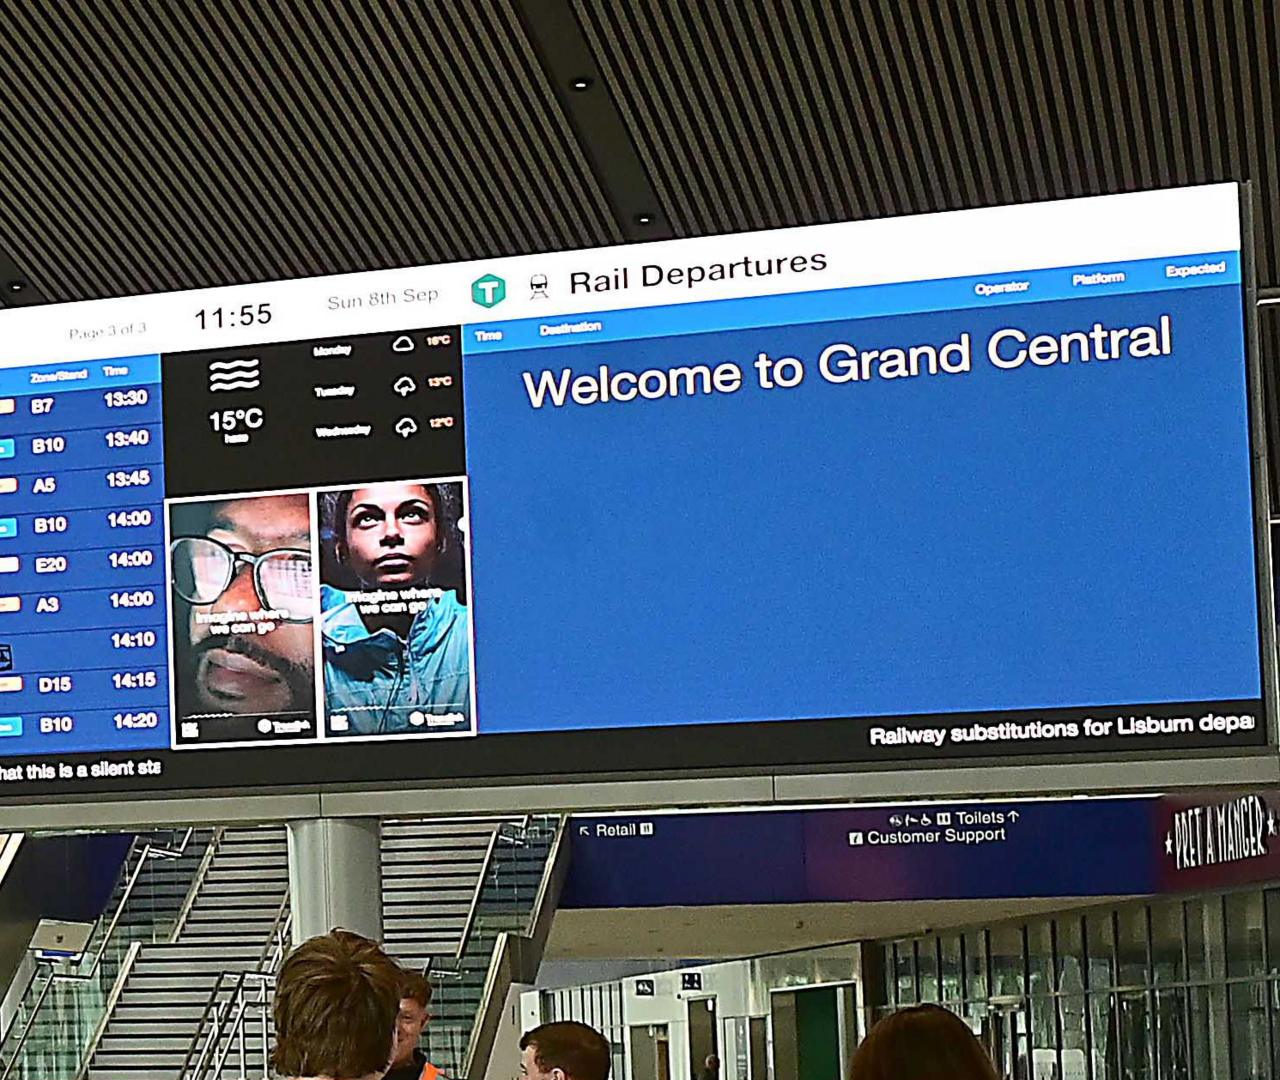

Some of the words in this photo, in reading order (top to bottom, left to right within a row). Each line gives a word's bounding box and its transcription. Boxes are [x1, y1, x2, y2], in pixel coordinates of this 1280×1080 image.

[570, 267, 628, 295] Rail
[641, 253, 828, 289] Departures
[974, 281, 1030, 296] Operator
[1072, 272, 1125, 286] Platform
[1165, 260, 1226, 278] Expected
[327, 296, 363, 310] Sun
[368, 291, 396, 306] 8th
[403, 288, 439, 304] Sep
[195, 303, 272, 330] 11:55
[522, 363, 741, 408] Welcome
[754, 353, 803, 389] to
[819, 333, 970, 383] Grand
[987, 315, 1171, 369] Central
[31, 397, 54, 415] B7
[104, 389, 148, 408] 13:30
[32, 436, 65, 454] B10
[105, 429, 149, 448] 13:40
[32, 477, 56, 494] A5
[106, 469, 151, 487] 13:45
[35, 556, 67, 573] E20
[108, 550, 153, 568] 14:00
[36, 596, 59, 613] A3
[110, 590, 154, 608] 14:00
[111, 631, 155, 648] 14:10
[870, 726, 947, 747] Railway
[950, 720, 1080, 743] substitutions
[1082, 718, 1114, 736] for
[1117, 716, 1194, 735] Lisburn
[25, 763, 56, 780] this
[58, 762, 74, 779] is
[76, 764, 89, 778] a
[90, 760, 135, 778] silent
[596, 823, 636, 837] Retail
[955, 811, 1005, 825] Toilets
[867, 830, 941, 845] Customer
[944, 827, 1006, 844] Support
[1174, 807, 1202, 870] PRET
[1206, 805, 1216, 865] A
[1216, 795, 1265, 863] MANGER
